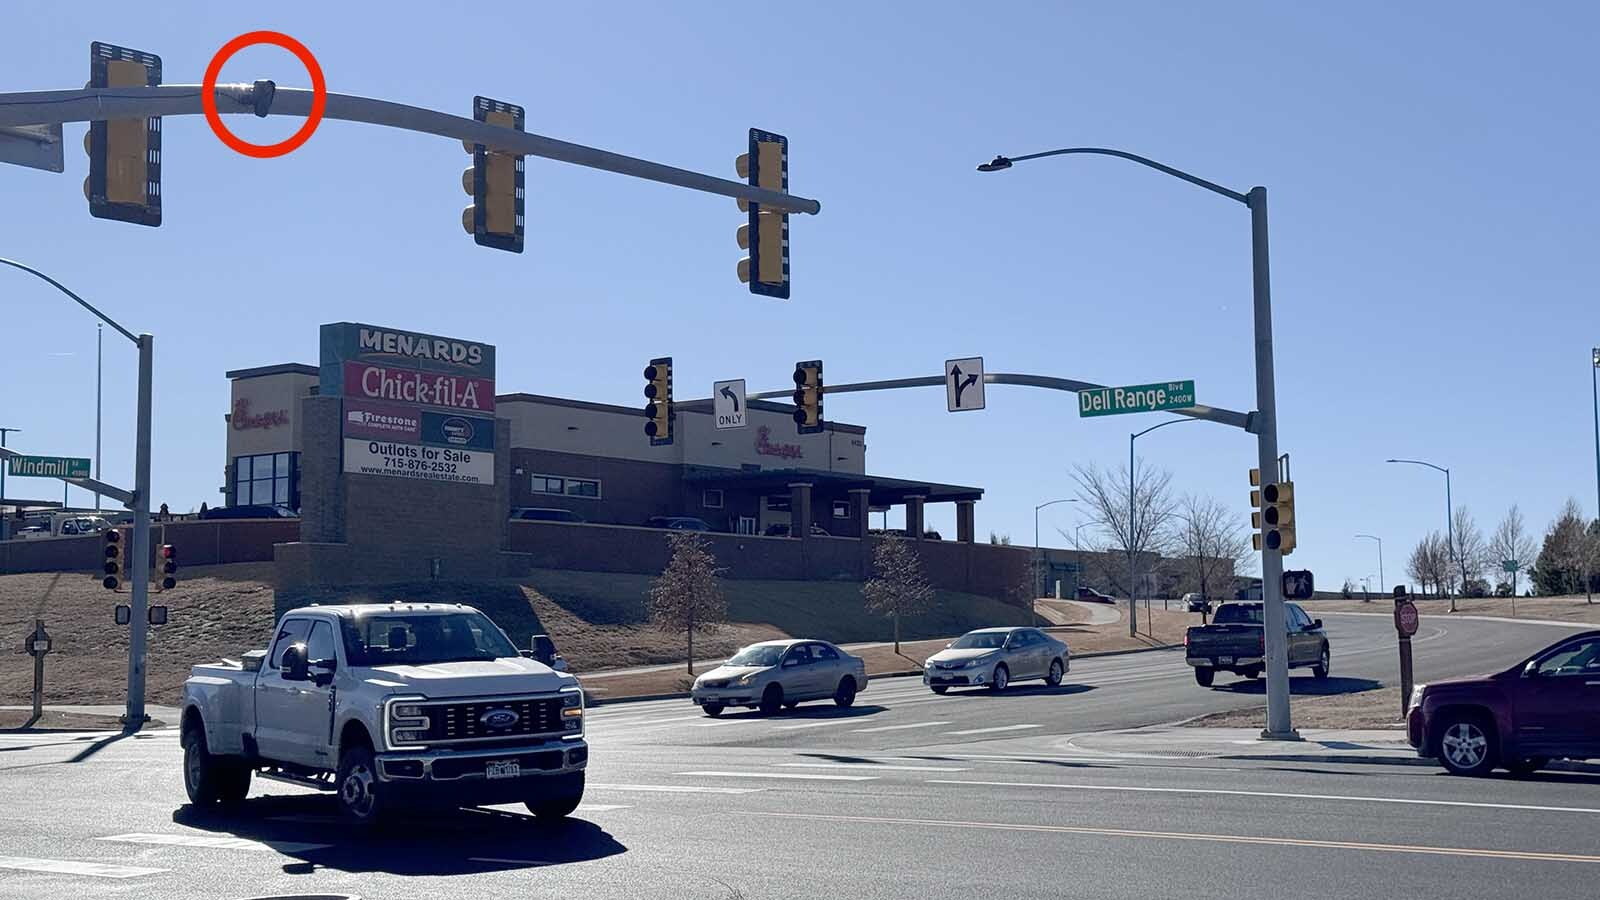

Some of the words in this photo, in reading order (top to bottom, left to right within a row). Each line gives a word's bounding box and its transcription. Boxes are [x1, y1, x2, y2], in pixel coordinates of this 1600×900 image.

[359, 328, 482, 364] MENARDS
[361, 366, 479, 409] Chick-fil-A
[1081, 389, 1111, 412] Dell
[1114, 388, 1167, 410] Range
[1168, 383, 1184, 391] Blvd
[364, 411, 417, 427] Firestone
[719, 414, 742, 425] ONLY
[368, 441, 418, 459] Outlots
[421, 447, 440, 460] for
[443, 449, 471, 463] Sale
[12, 457, 69, 476] Windmill
[360, 466, 479, 482] www.menardsrealestate.com
[383, 457, 457, 473] 715-876-2532
